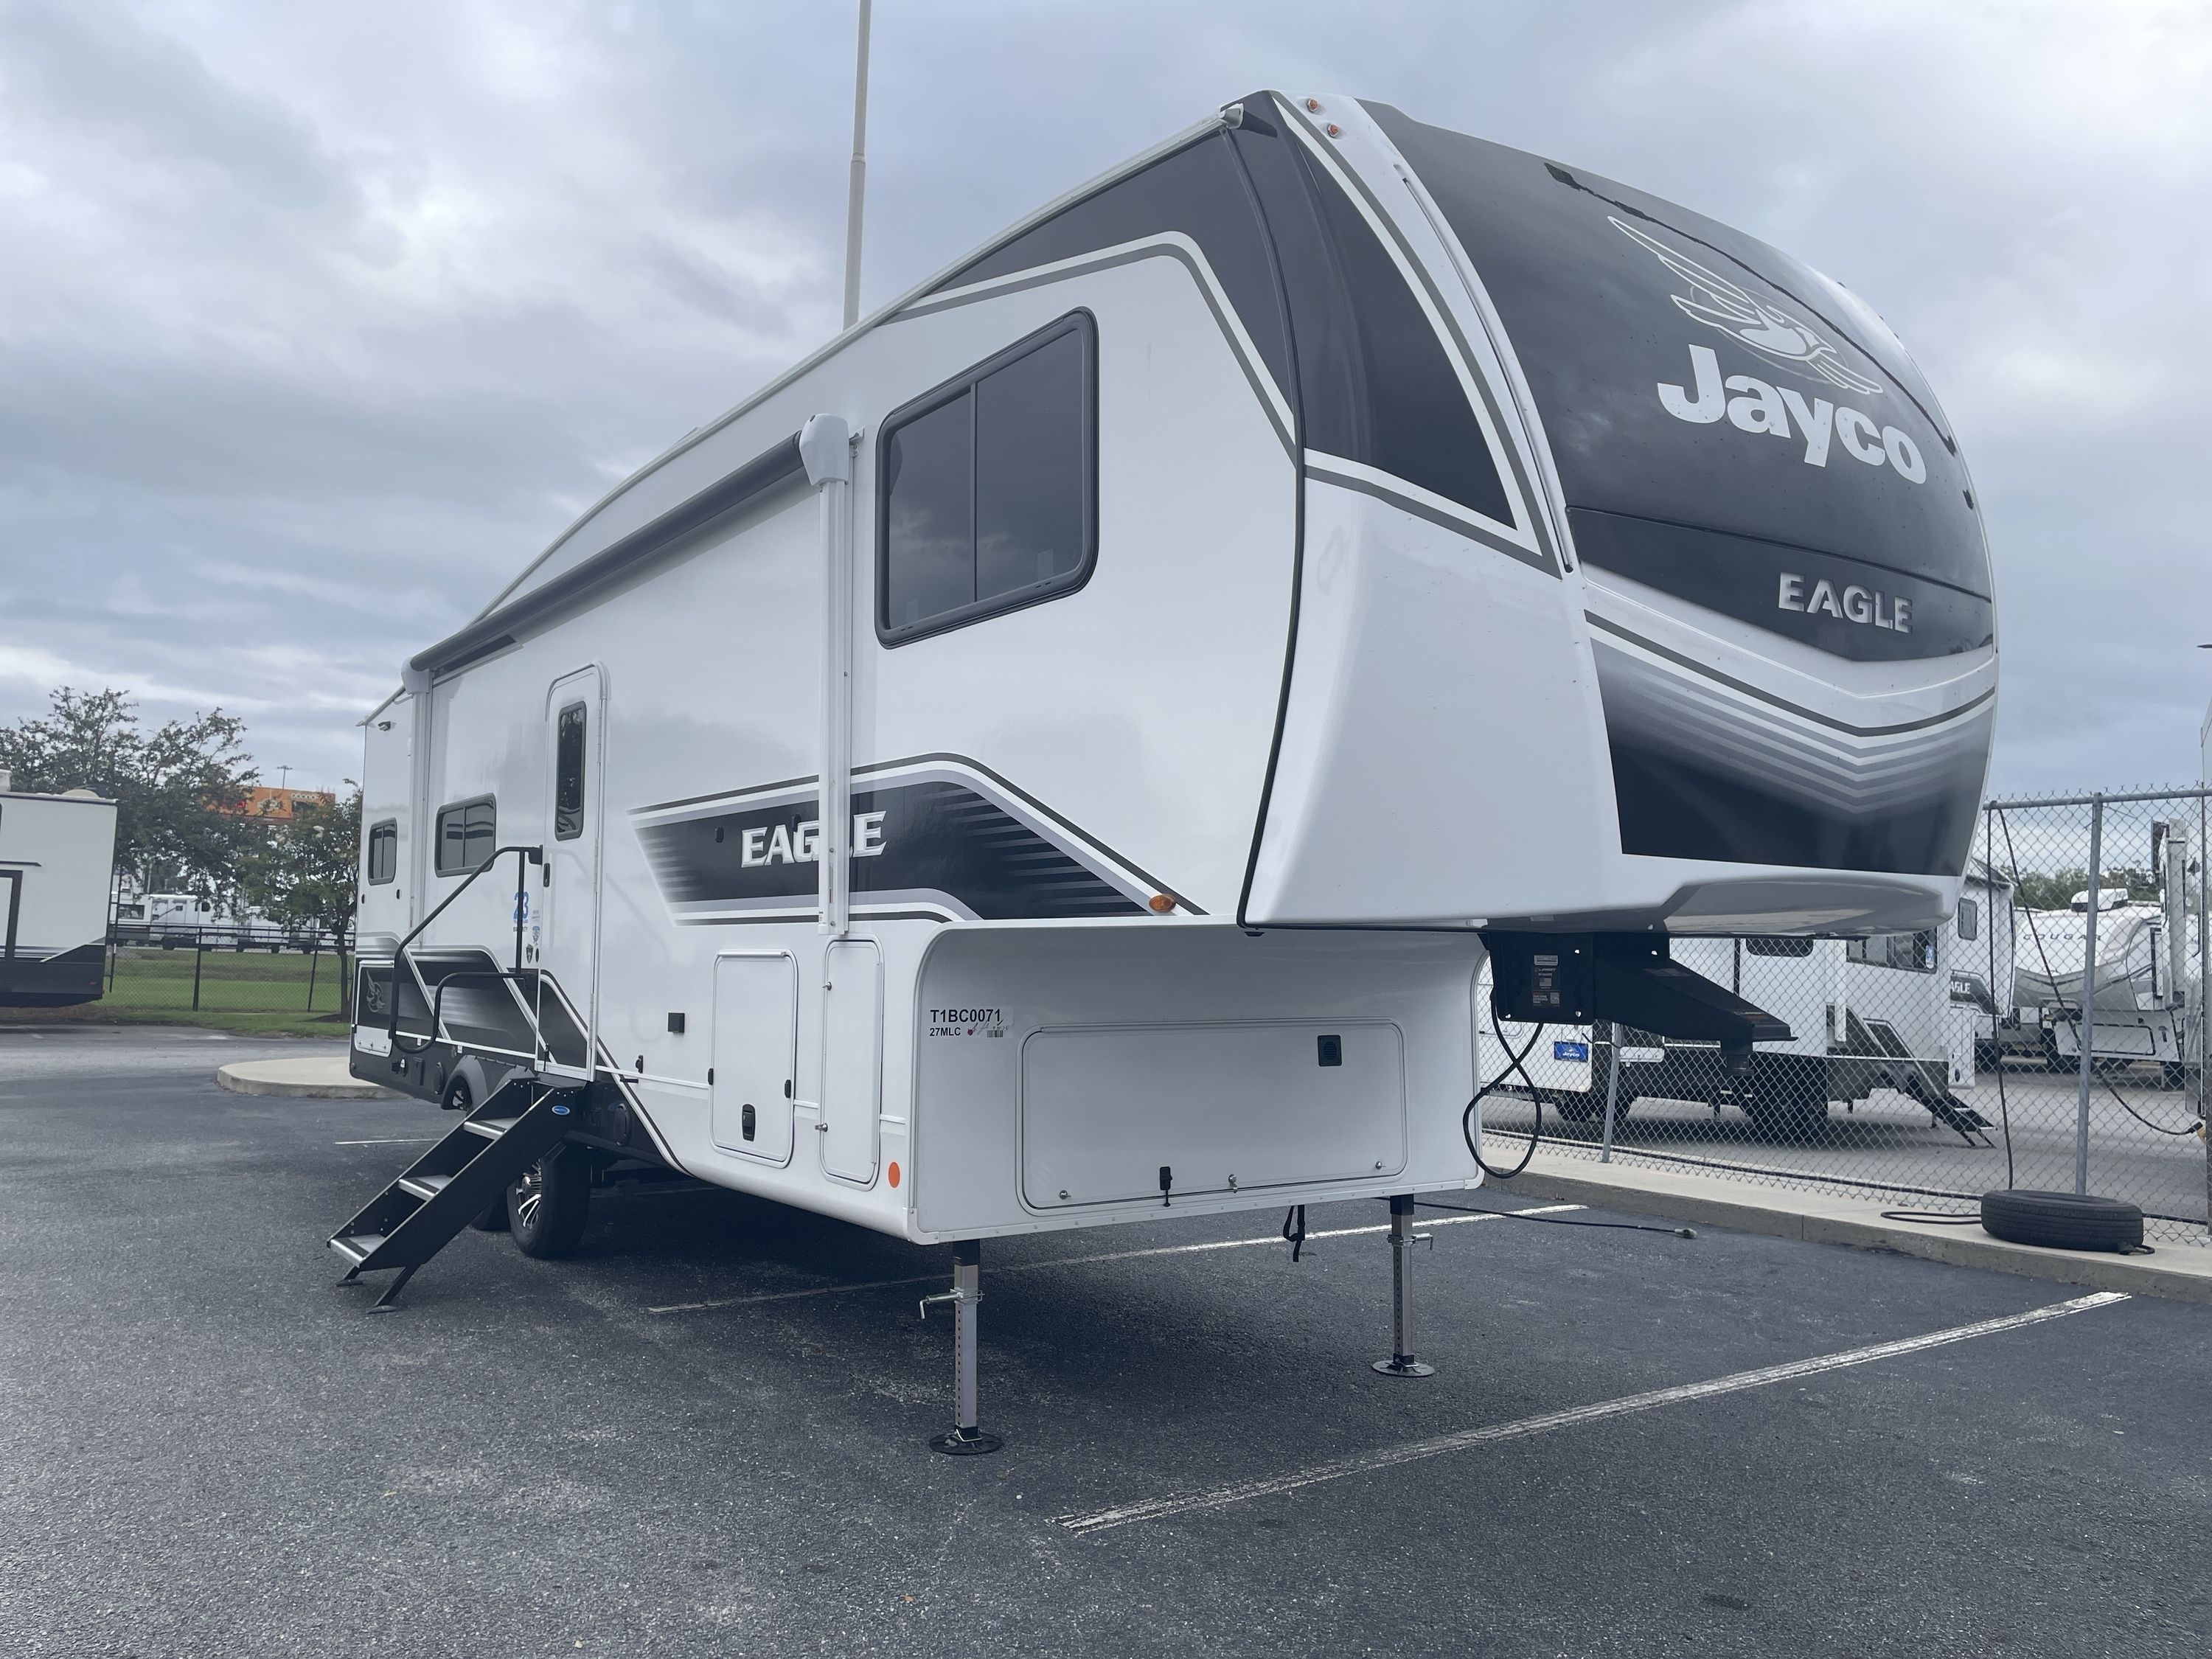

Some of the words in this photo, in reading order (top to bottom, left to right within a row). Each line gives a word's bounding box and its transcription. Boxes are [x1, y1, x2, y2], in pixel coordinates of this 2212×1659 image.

[1657, 344, 1927, 484] Jayco
[1777, 572, 1912, 633] EAGLE
[740, 810, 887, 868] EAGE
[1950, 981, 1971, 994] AGLE
[930, 1009, 1001, 1023] T1BC0071
[930, 1027, 961, 1036] 27MLC
